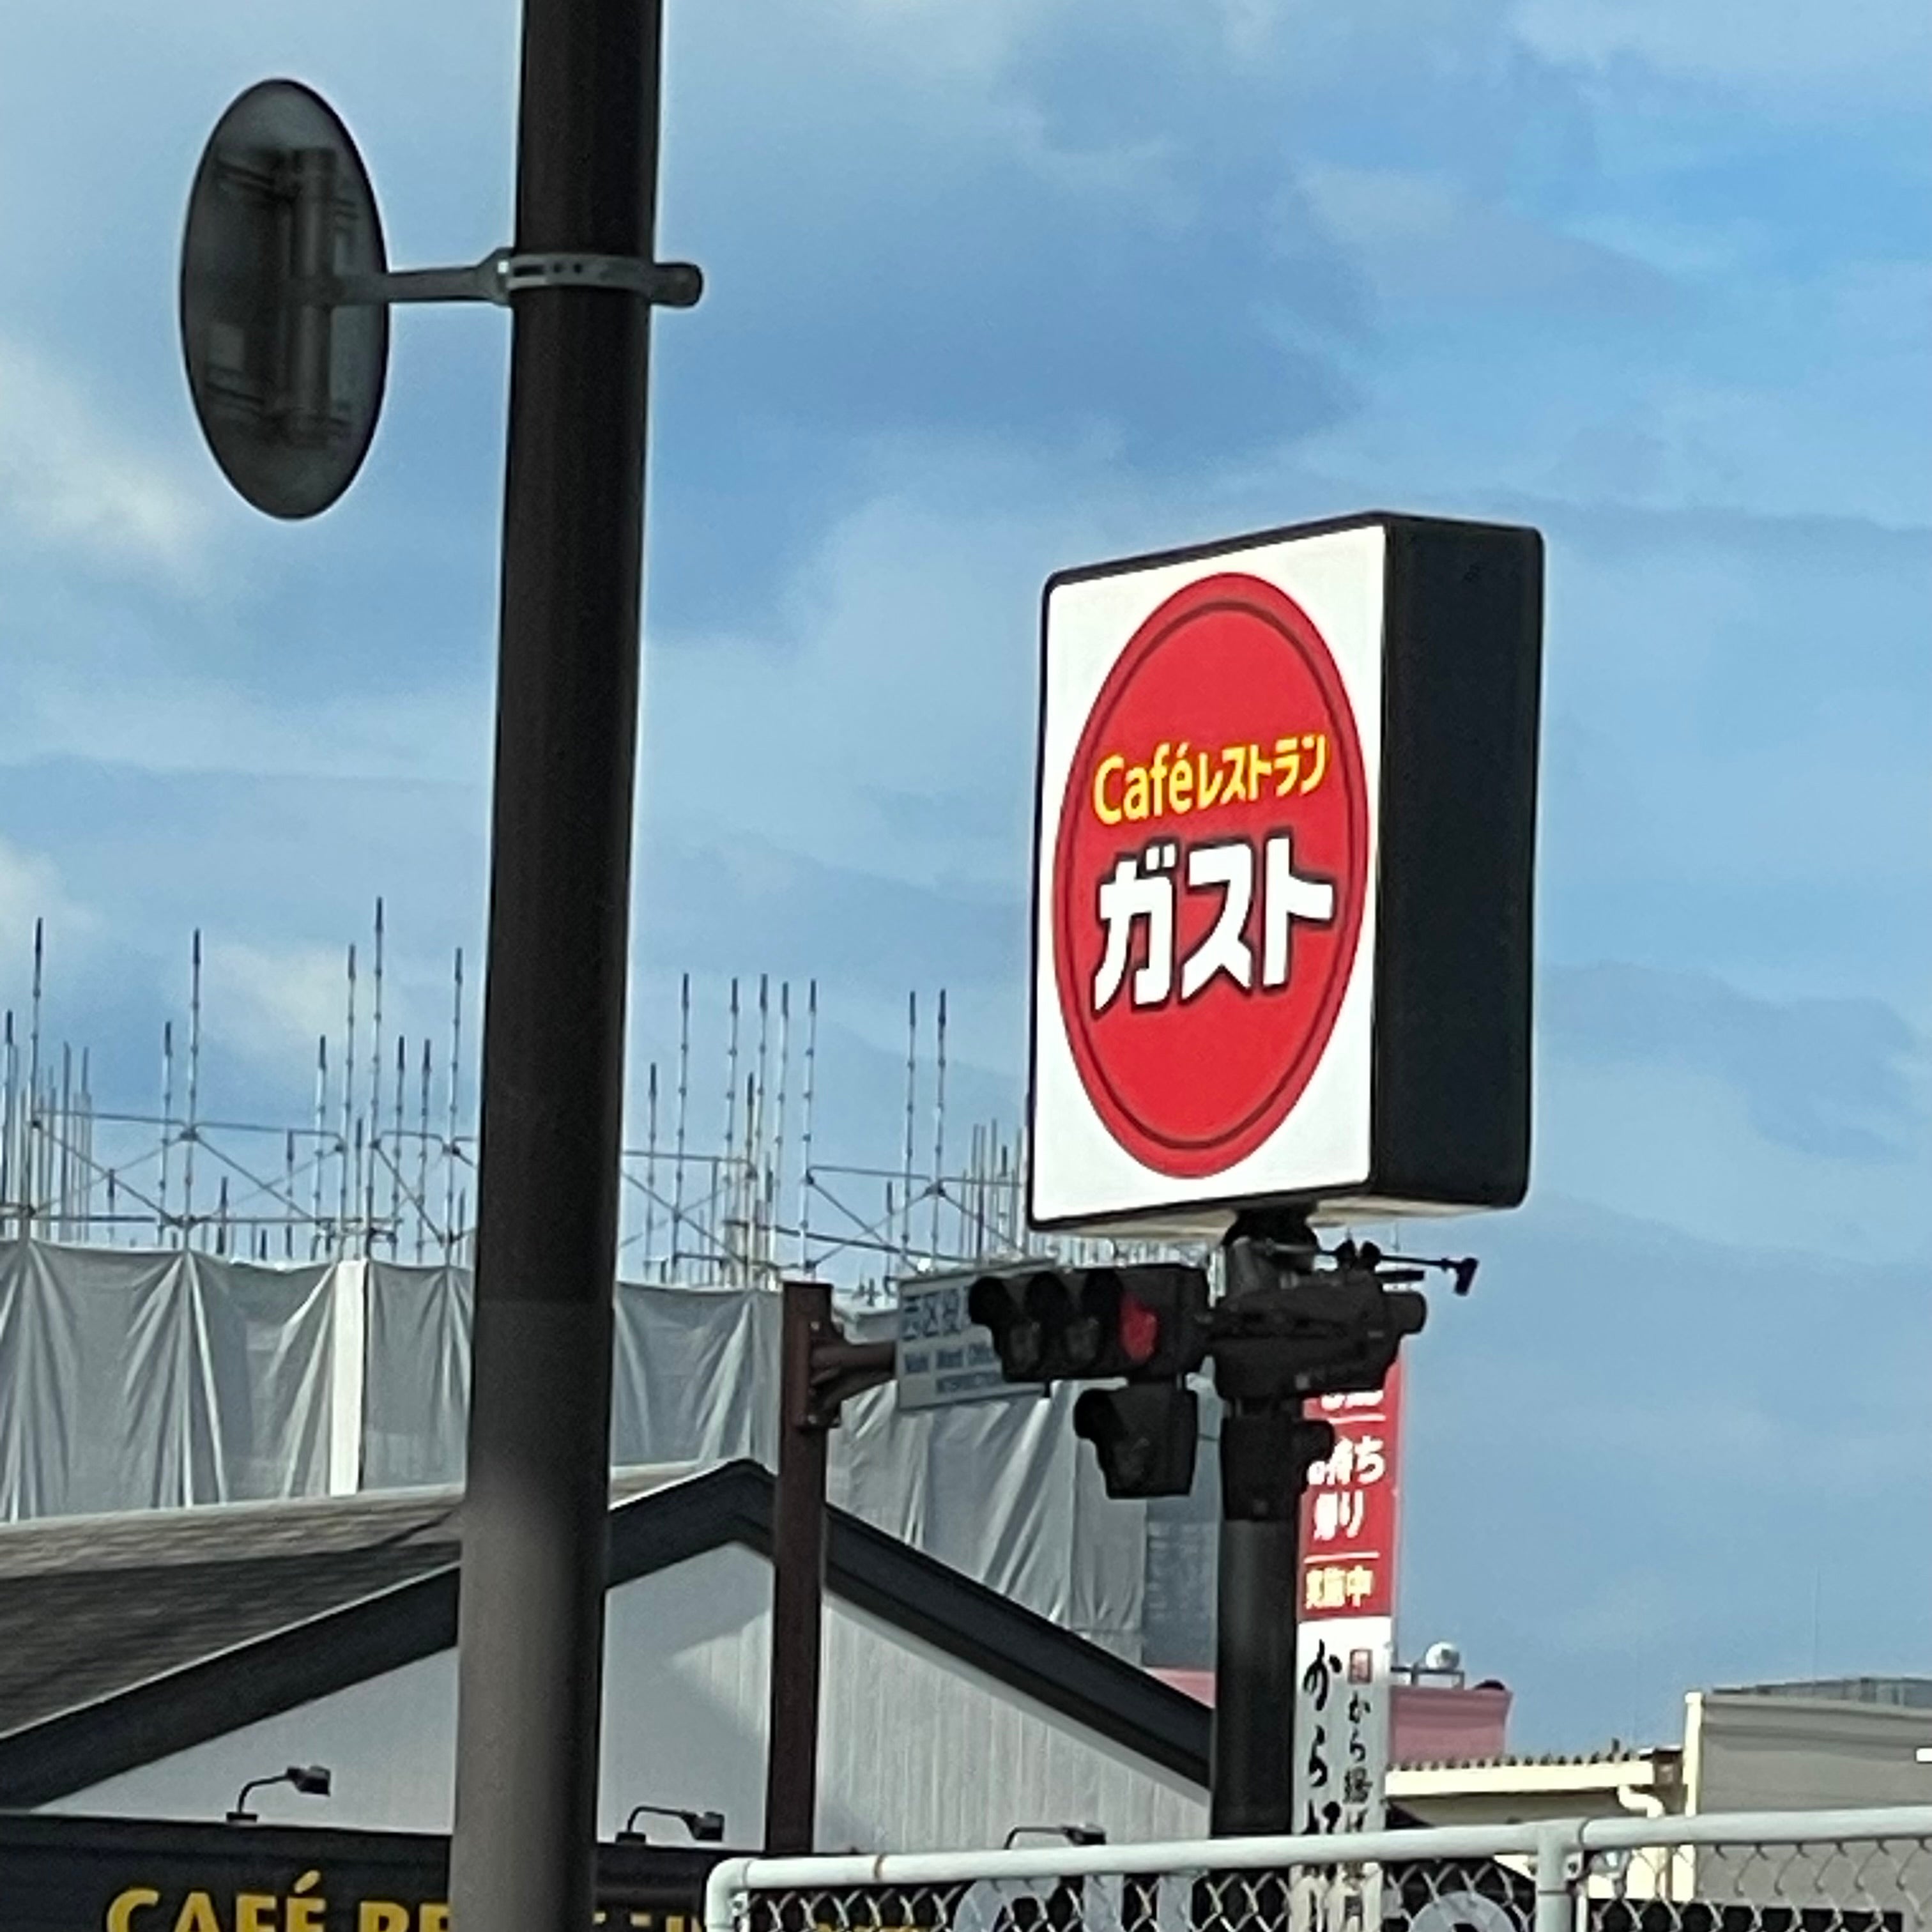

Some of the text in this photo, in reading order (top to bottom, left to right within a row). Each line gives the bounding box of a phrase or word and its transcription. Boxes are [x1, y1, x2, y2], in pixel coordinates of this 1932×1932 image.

[1092, 734, 1326, 825] Caféレストラン
[1093, 833, 1334, 1013] ガスト
